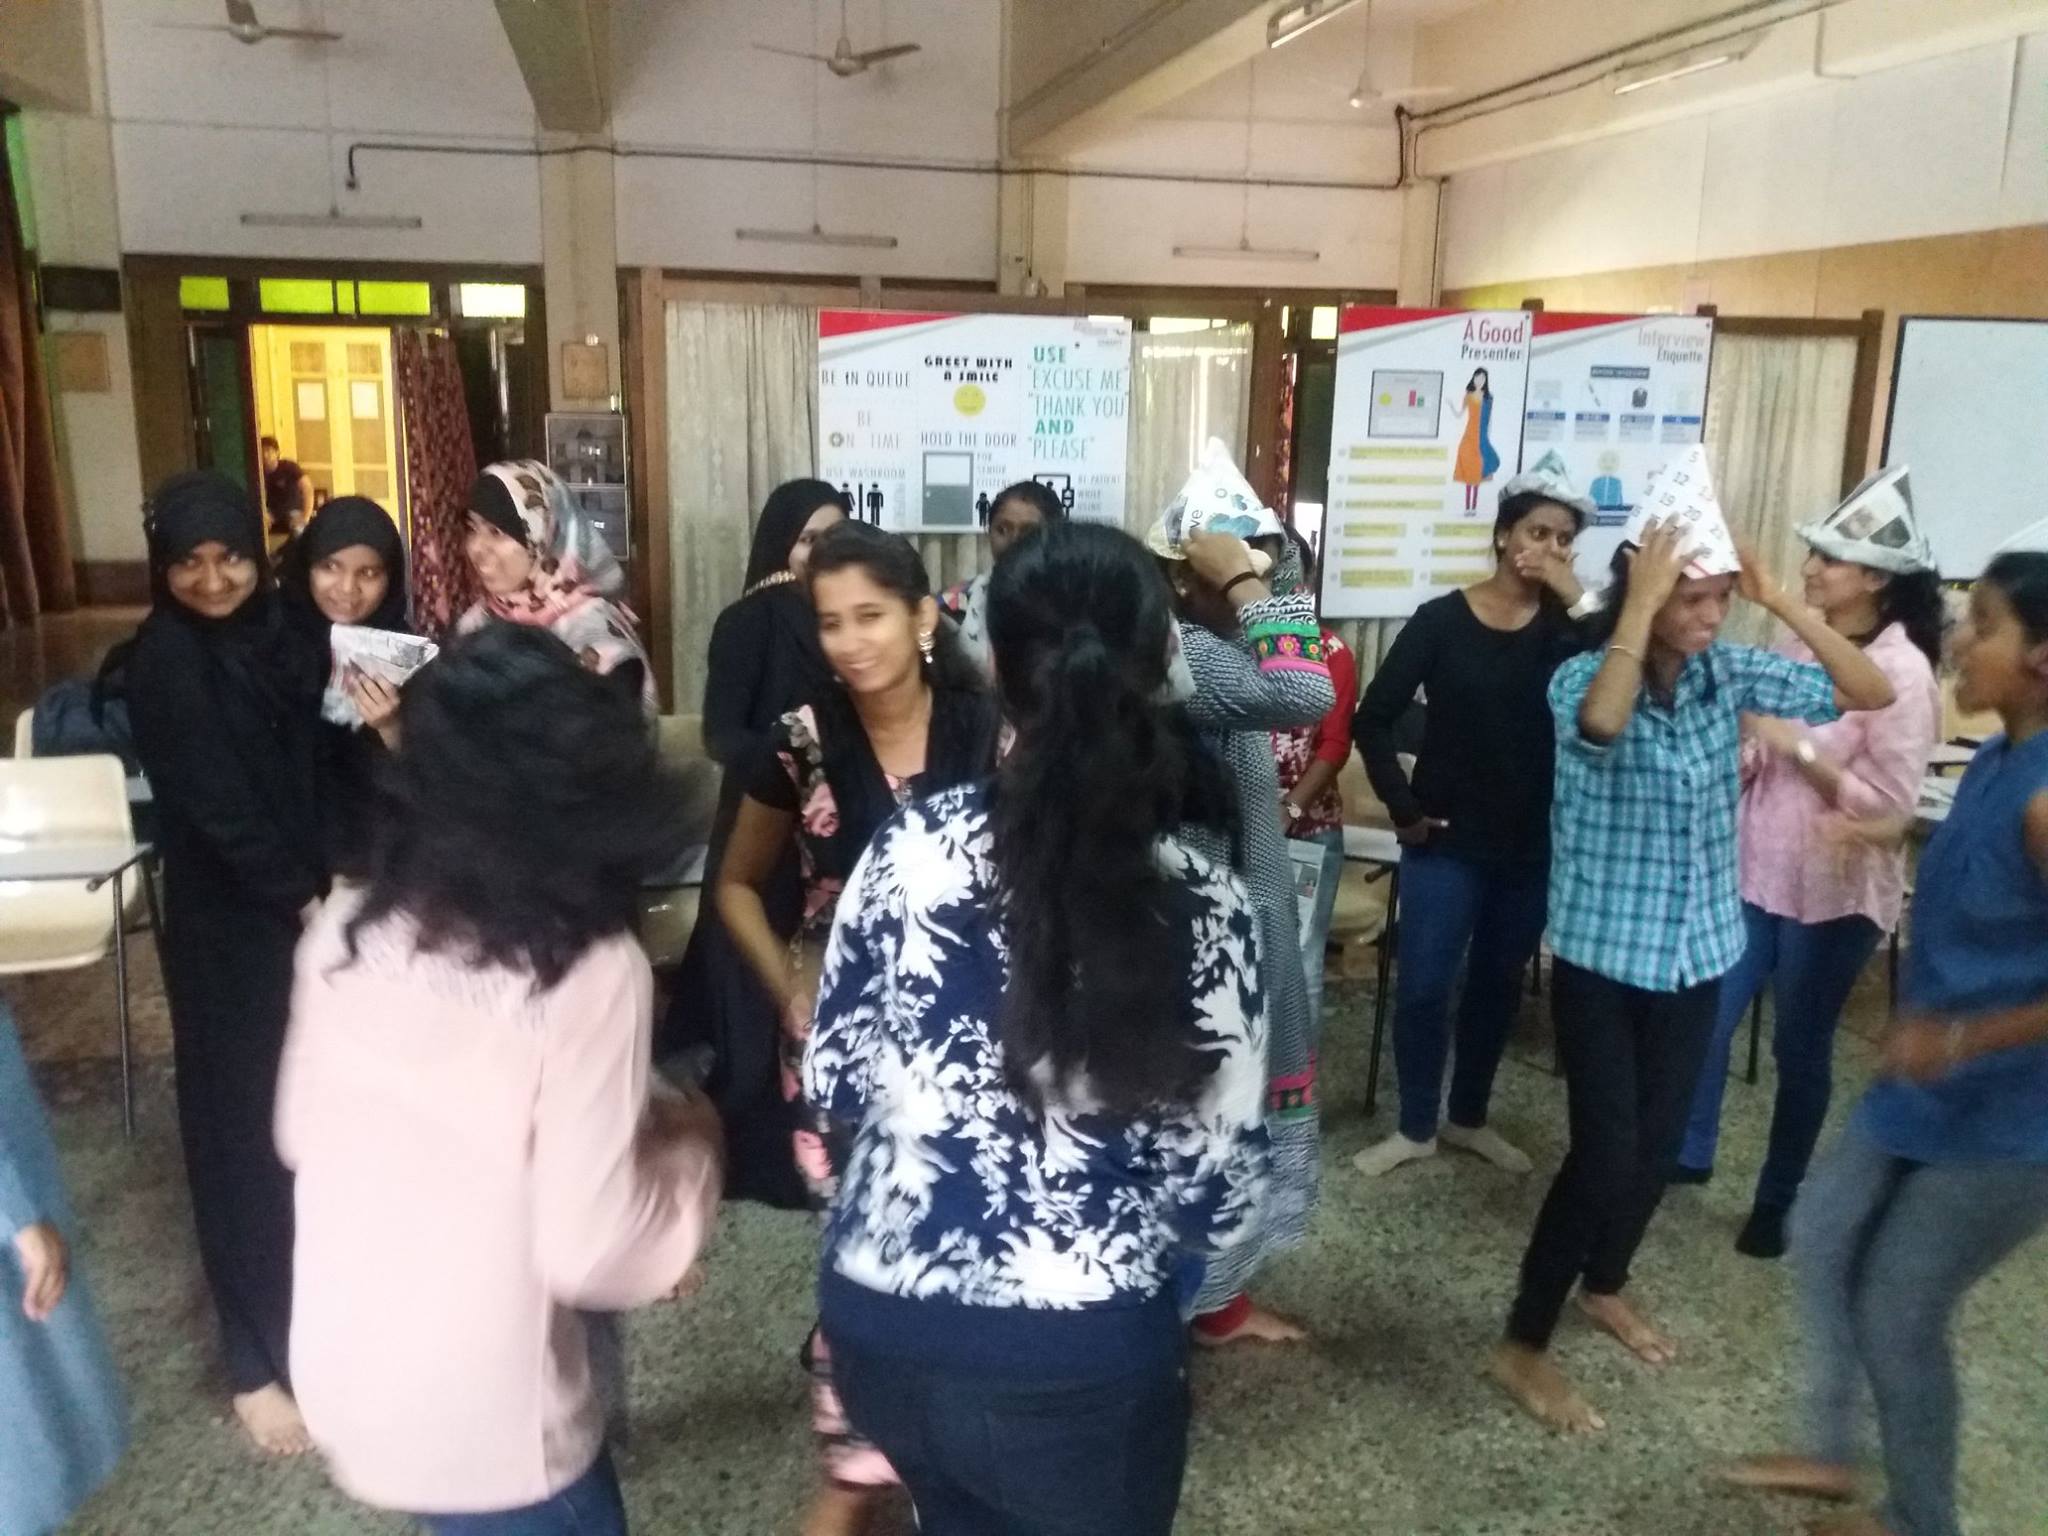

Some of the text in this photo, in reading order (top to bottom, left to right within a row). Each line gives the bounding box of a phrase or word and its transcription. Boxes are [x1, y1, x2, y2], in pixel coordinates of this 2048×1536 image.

[1463, 317, 1524, 344] A Good
[1638, 327, 1705, 347] Interview
[1033, 345, 1066, 363] USE
[1460, 343, 1521, 361] Presenter
[924, 355, 1013, 369] GREET WITH
[821, 369, 911, 388] BE IN QUEUE
[958, 370, 999, 384] SMILE
[857, 408, 872, 427] BE
[1034, 418, 1074, 436] AND
[871, 432, 902, 449] TIME
[920, 431, 1017, 448] HOLD THE DOOR
[849, 465, 906, 480] WASHROOM
